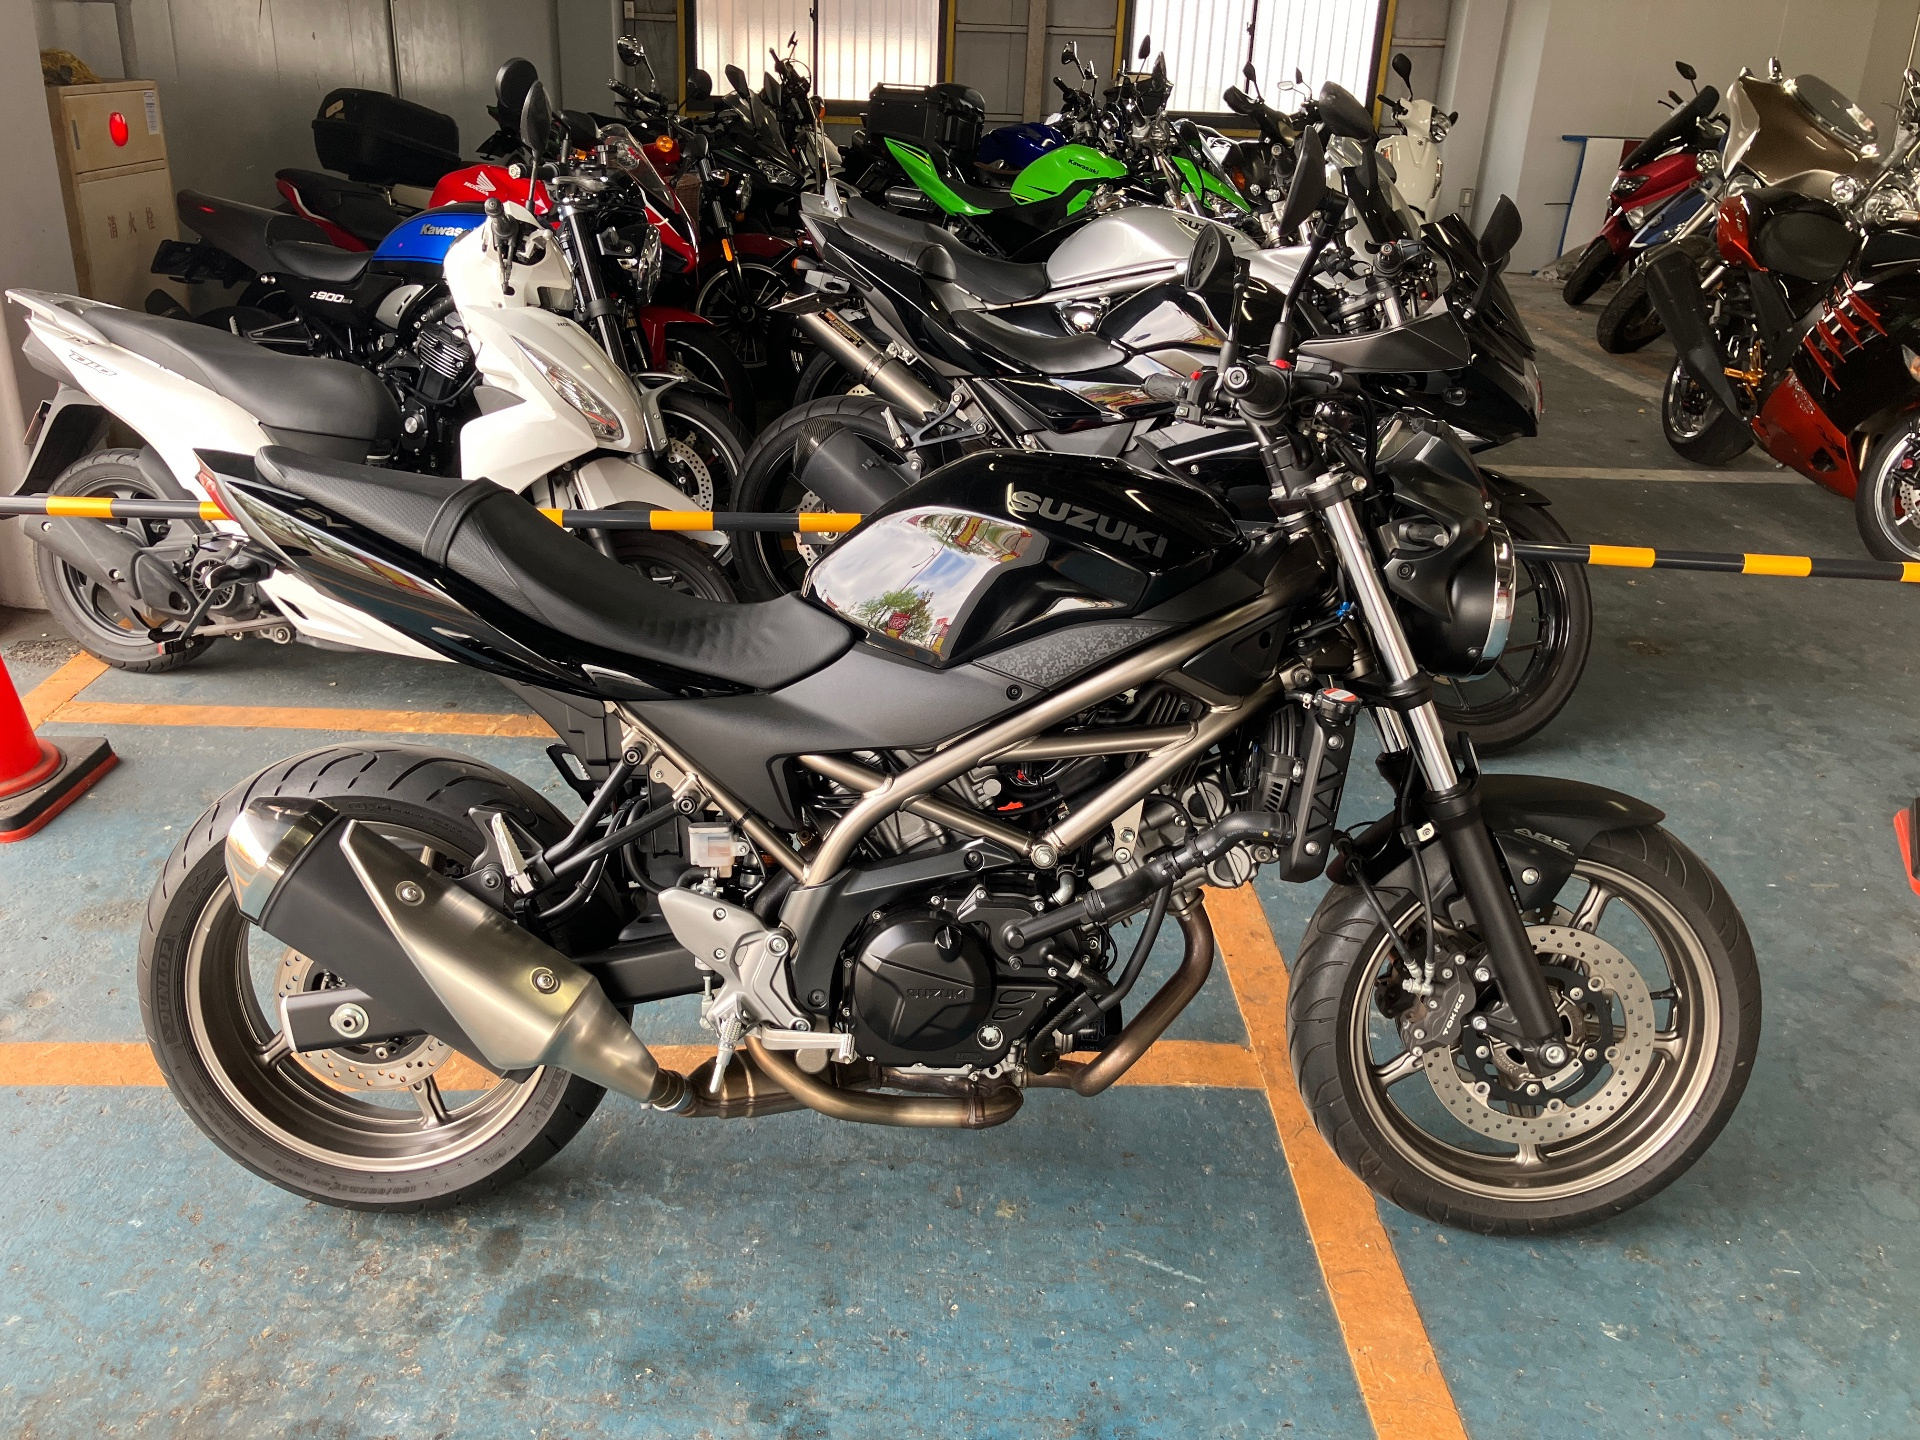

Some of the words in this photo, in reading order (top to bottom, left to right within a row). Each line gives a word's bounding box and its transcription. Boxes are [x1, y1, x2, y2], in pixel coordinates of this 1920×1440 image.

[1068, 159, 1099, 175] Kawasaki
[463, 181, 489, 196] HONDA
[420, 223, 477, 237] Kawas
[1012, 491, 1169, 558] SUZUKI
[1513, 828, 1571, 850] ABS
[157, 941, 173, 1025] DUNLOP
[906, 988, 967, 999] SUZUKI
[1442, 993, 1465, 1036] TOKICO
